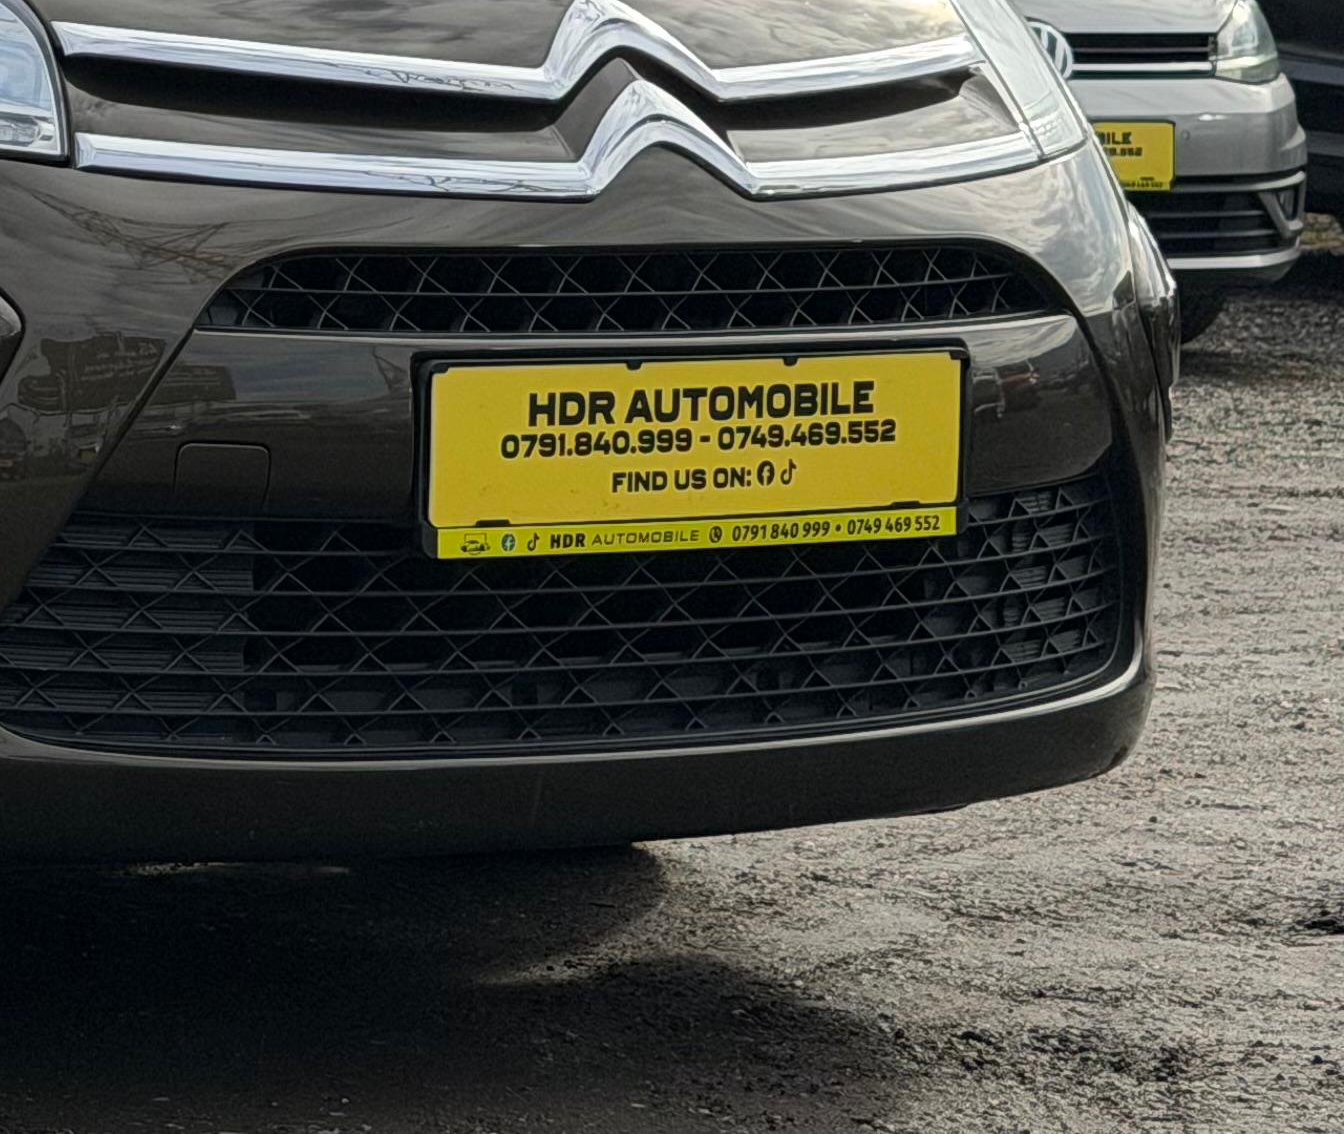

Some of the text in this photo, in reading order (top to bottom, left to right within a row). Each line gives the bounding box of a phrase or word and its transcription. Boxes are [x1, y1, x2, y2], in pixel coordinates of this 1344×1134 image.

[528, 381, 875, 427] HDR AUTOMOBILE
[501, 428, 693, 459] 0791.840.999
[718, 419, 897, 451] 0749.469.552
[612, 467, 752, 493] FIND US ON:
[550, 533, 586, 549] HDR
[592, 530, 700, 546] AUTOMOBILE
